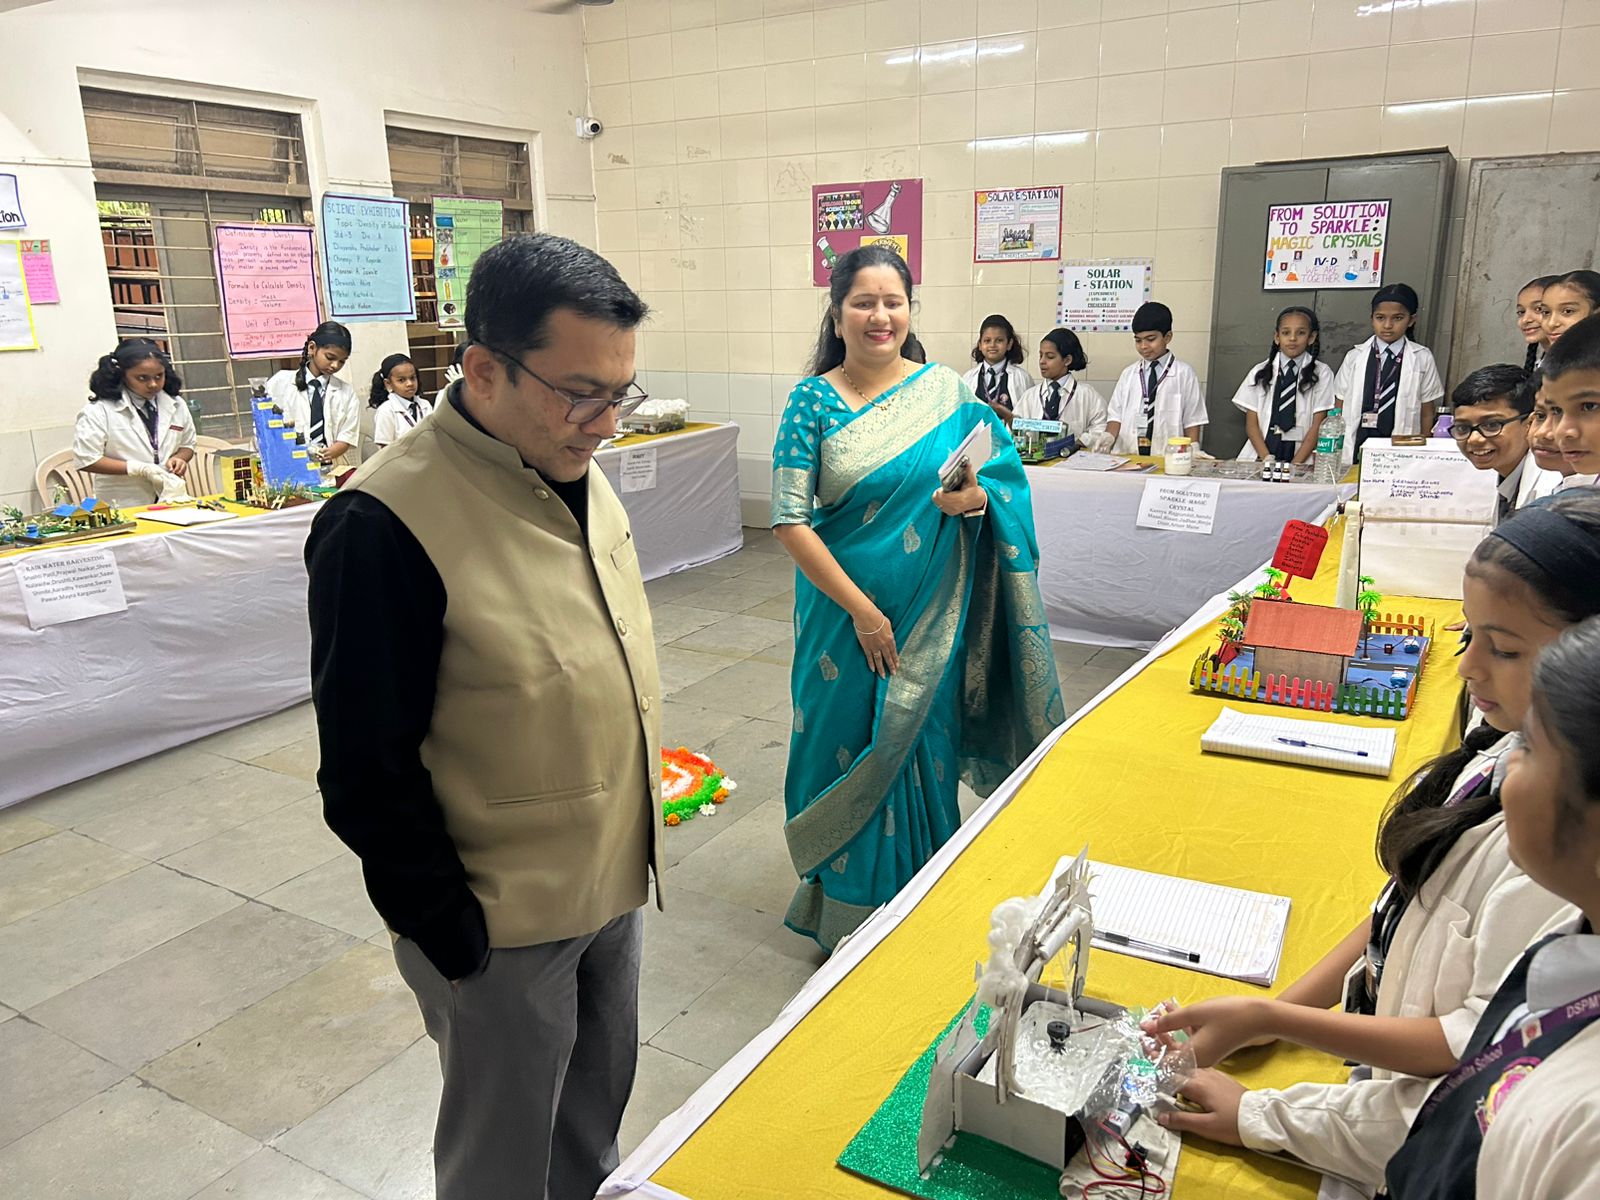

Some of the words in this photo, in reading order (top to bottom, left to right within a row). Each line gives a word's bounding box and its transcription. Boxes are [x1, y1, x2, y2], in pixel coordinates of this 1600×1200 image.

[988, 192, 1014, 202] SOLAR
[1016, 192, 1020, 200] E
[1022, 190, 1059, 200] STATION
[327, 202, 356, 216] SCIENCE
[360, 206, 401, 218] EXHIBITION
[1270, 206, 1304, 222] FROM
[1313, 203, 1388, 220] SOLUTION
[1280, 222, 1298, 236] TO
[1270, 236, 1316, 250] MAGIC
[1322, 234, 1383, 249] CRYSTALS
[1086, 268, 1121, 278] SOLAR
[1305, 266, 1320, 274] WE
[1324, 265, 1338, 274] ARE
[1301, 273, 1341, 284] TOGETHER
[228, 280, 250, 289] Formula
[286, 280, 306, 290] Density
[1074, 280, 1080, 290] E
[1090, 280, 1134, 290] STATION
[246, 320, 258, 328] Unit
[274, 318, 296, 328] Density
[1176, 490, 1202, 498] SOLUTION
[42, 560, 66, 570] WATER
[1474, 1044, 1504, 1072] School
